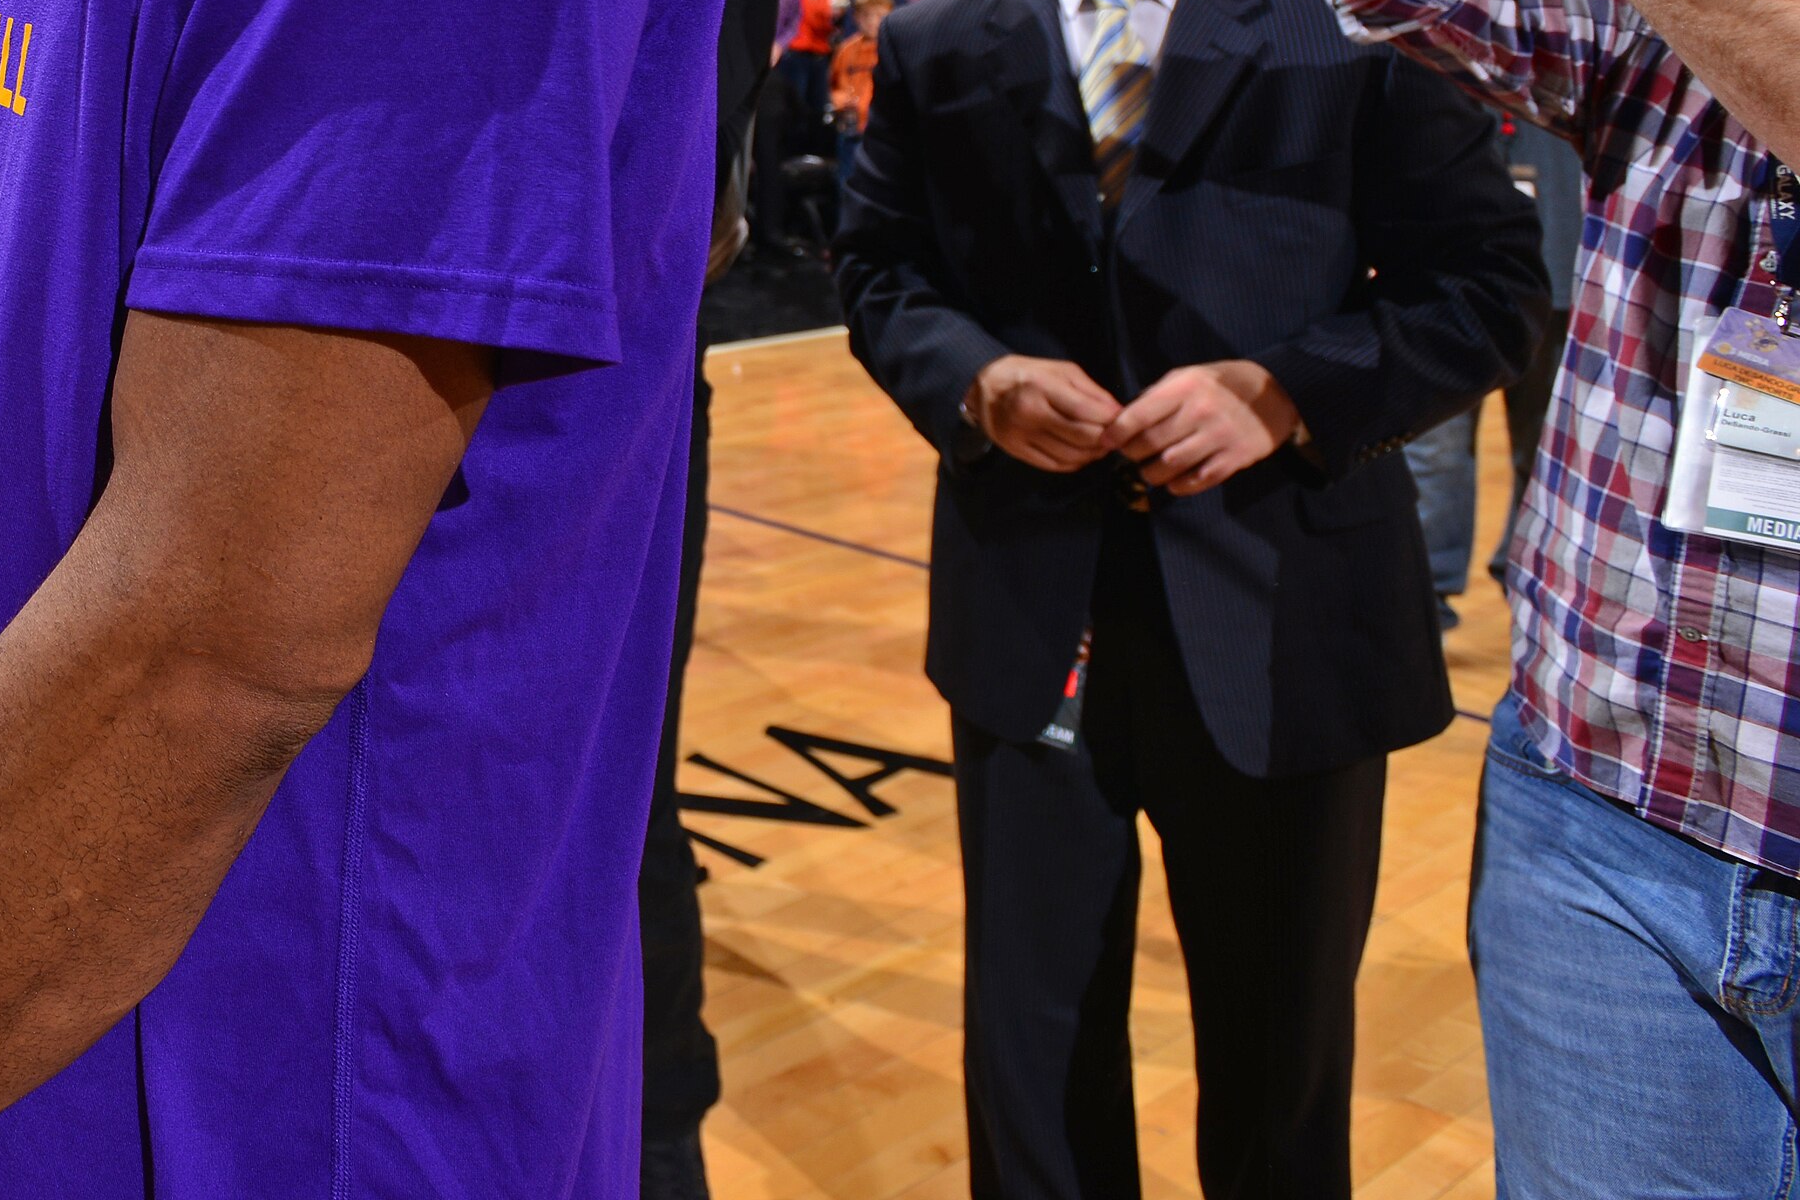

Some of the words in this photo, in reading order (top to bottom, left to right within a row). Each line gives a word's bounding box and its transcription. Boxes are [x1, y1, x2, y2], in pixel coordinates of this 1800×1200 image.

[1723, 408, 1757, 423] Luca
[1720, 418, 1792, 438] DeSando-Grassi
[1746, 515, 1800, 541] MEDIA
